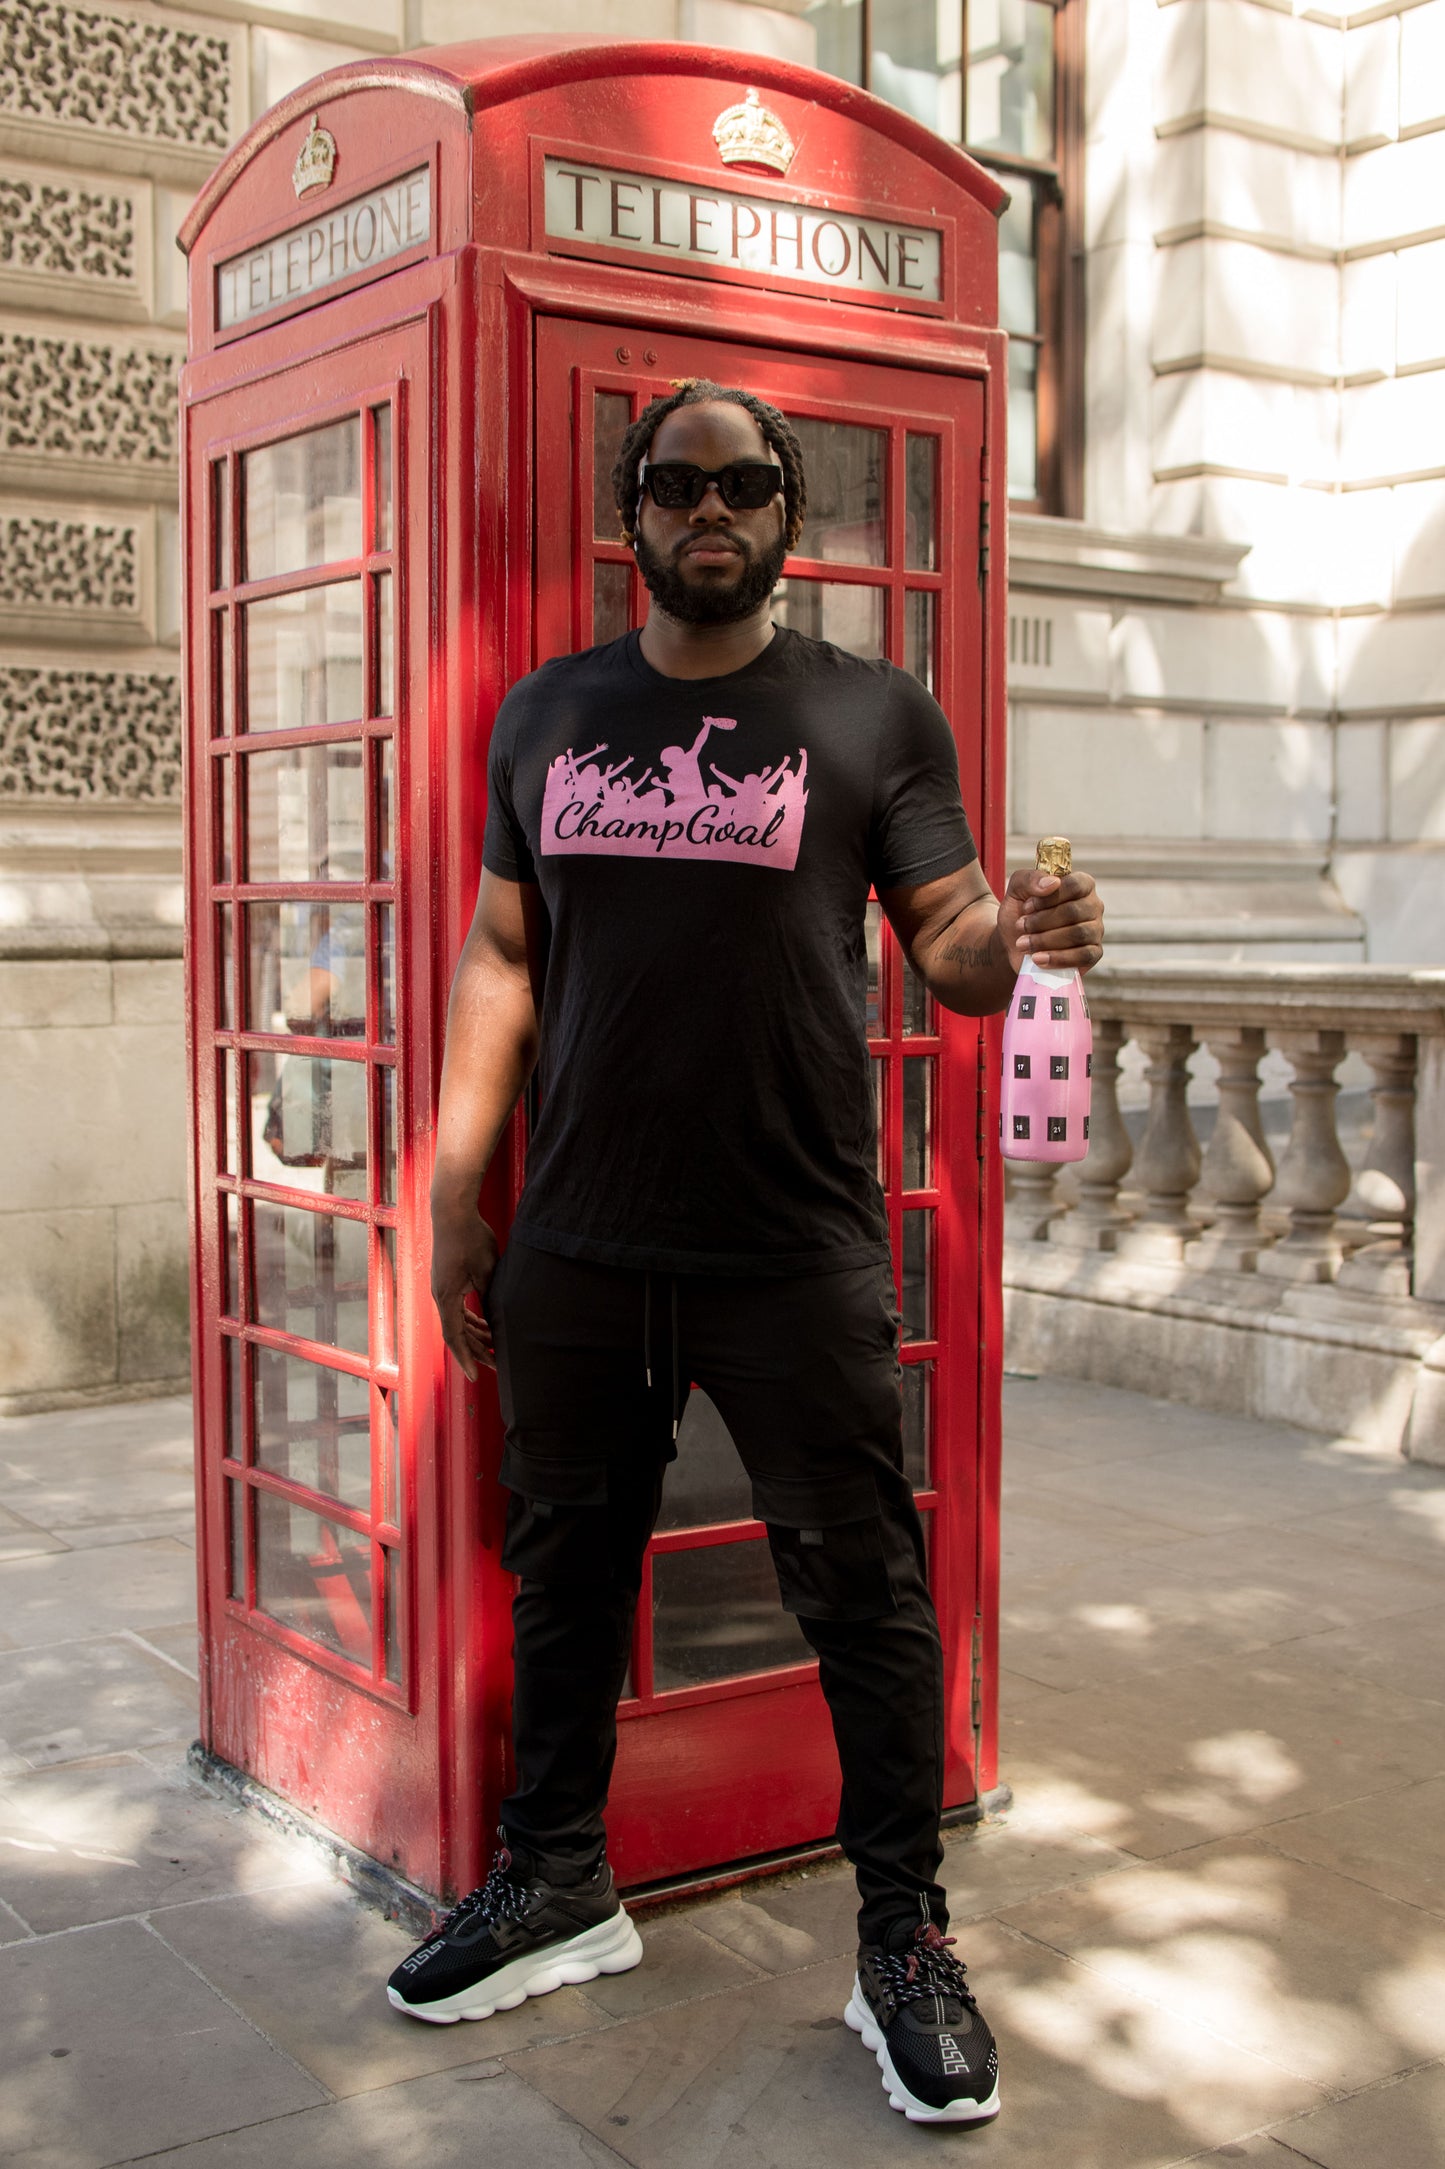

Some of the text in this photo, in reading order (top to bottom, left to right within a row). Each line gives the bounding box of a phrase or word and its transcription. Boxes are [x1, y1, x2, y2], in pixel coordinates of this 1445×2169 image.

[225, 177, 425, 318] TELEPHONE
[557, 169, 925, 290] TELEPHONE
[554, 800, 786, 852] ChampGoal
